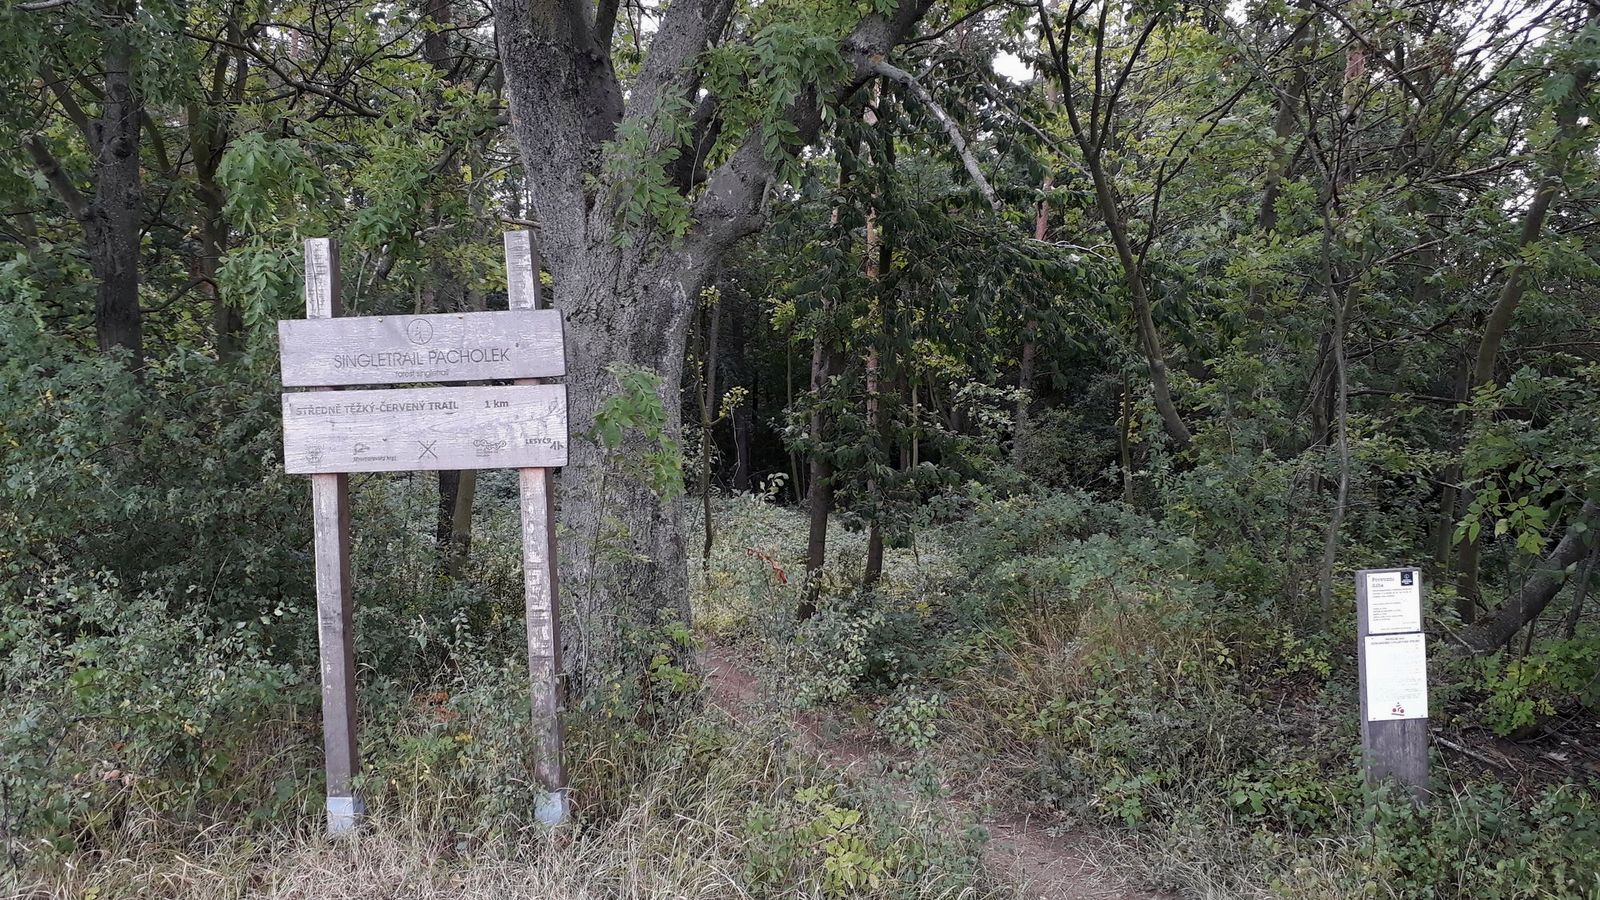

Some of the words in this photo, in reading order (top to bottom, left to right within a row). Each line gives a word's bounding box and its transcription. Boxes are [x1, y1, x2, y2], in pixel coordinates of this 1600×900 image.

[334, 352, 424, 369] SINGLETRAIL
[428, 347, 510, 364] PACHOLEK
[395, 370, 415, 378] forest
[295, 404, 342, 416] STŘEDNĚ
[428, 400, 459, 411] TRAIL
[484, 400, 491, 409] 1
[493, 398, 509, 409] km
